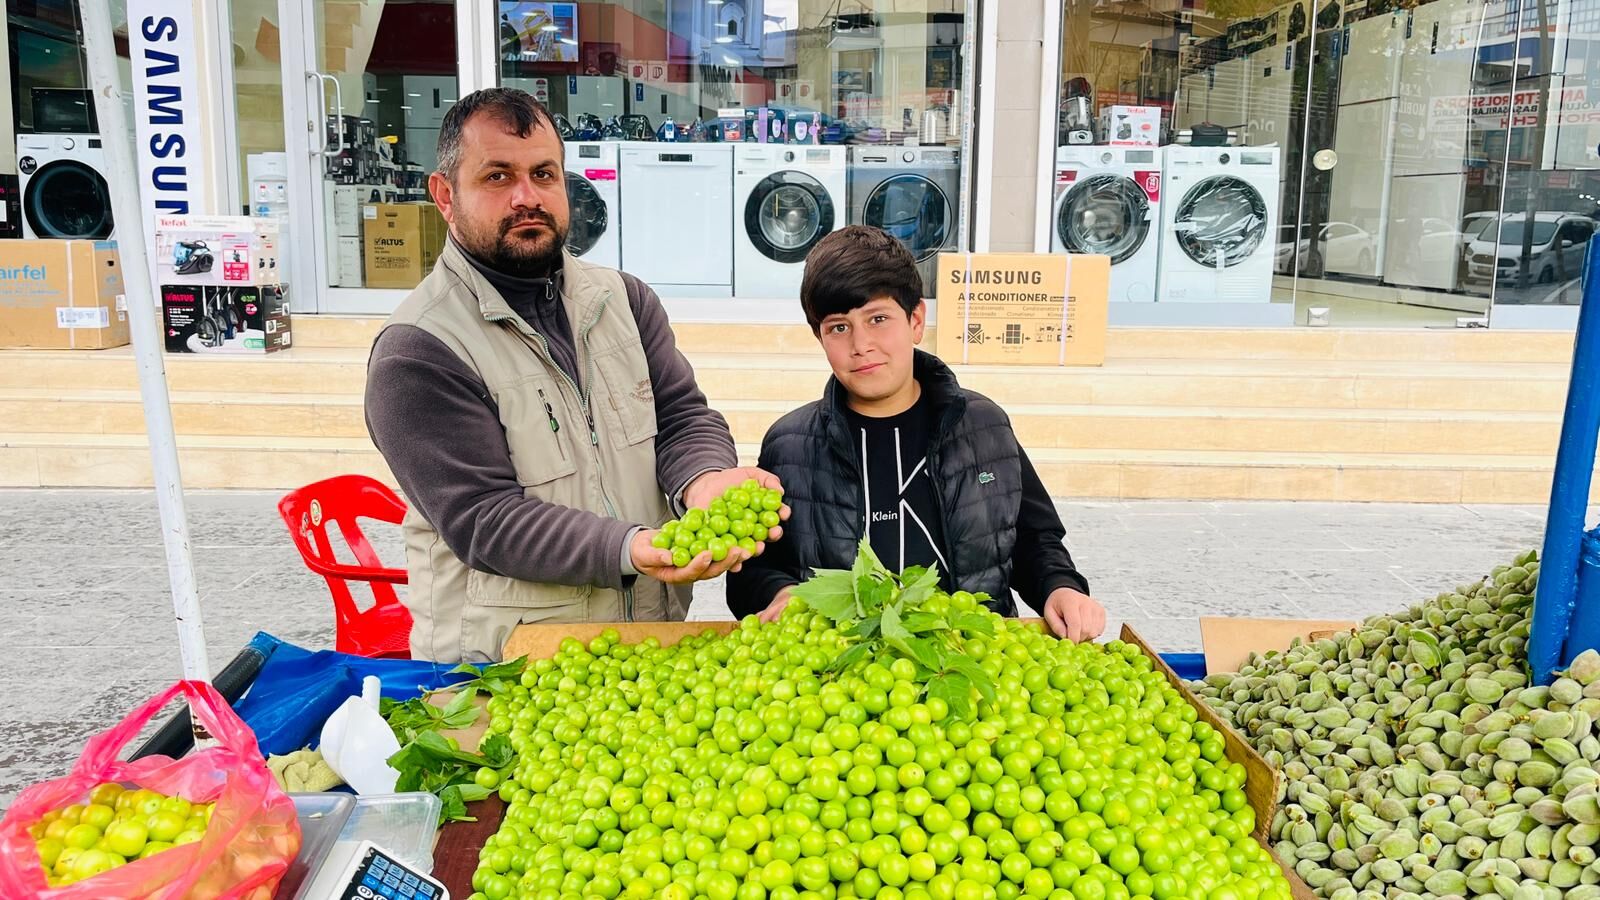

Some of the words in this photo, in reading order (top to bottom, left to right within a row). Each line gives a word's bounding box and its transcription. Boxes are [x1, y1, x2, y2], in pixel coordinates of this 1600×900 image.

[141, 16, 189, 214] SAMSUN
[160, 219, 188, 227] Tefal
[951, 270, 1042, 285] SAMSUNG
[958, 292, 975, 302] AR
[977, 292, 1048, 302] CONDITIONER
[872, 510, 898, 522] Klein
